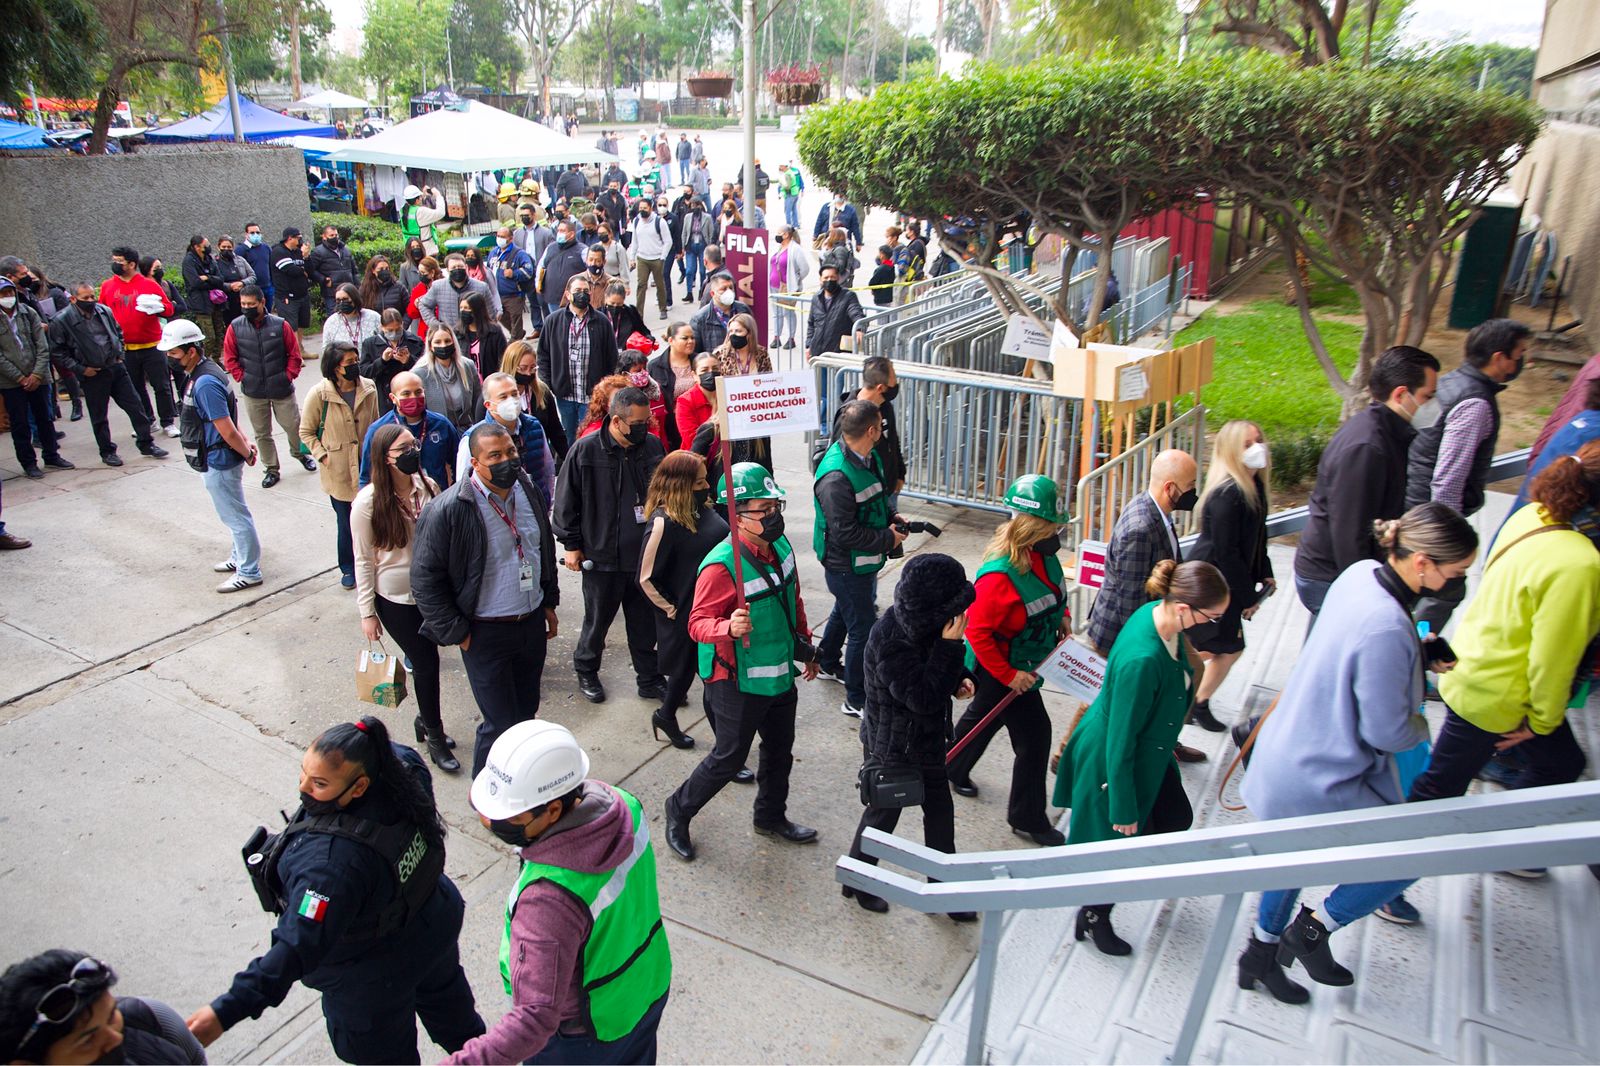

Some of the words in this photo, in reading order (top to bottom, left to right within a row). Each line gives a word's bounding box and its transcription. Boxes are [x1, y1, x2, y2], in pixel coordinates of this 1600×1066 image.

[727, 232, 767, 255] FILA
[727, 396, 806, 413] COMUNICACIÓN
[730, 387, 785, 402] DIRECCIÓN
[788, 386, 801, 395] DE
[750, 411, 787, 423] SOCIAL
[1058, 660, 1071, 670] DE
[1070, 668, 1103, 690] GABINET
[1060, 651, 1105, 681] COORDINAC
[537, 770, 576, 793] BRIGADISTA
[398, 831, 422, 876] POLIC
